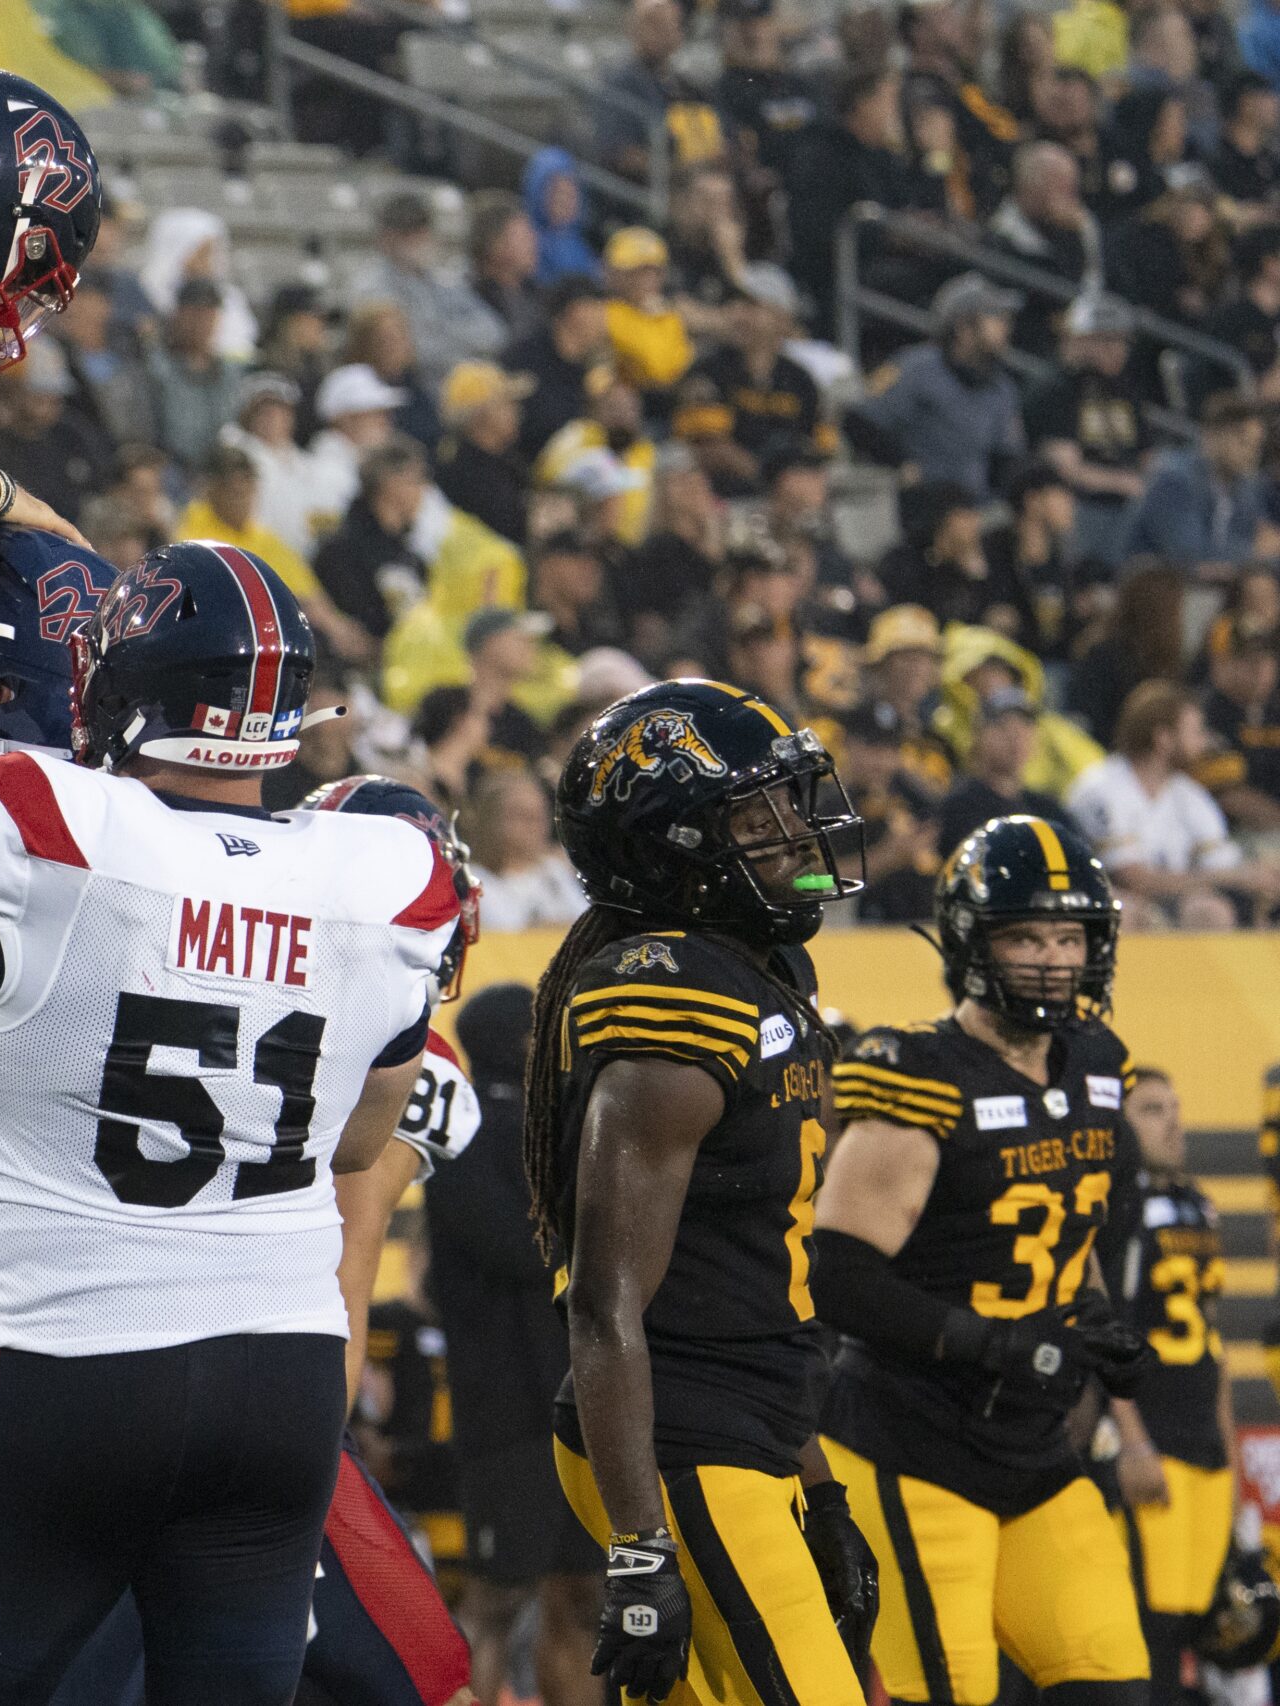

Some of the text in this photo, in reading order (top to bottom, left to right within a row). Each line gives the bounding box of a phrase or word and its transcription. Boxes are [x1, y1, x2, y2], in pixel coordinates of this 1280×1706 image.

[245, 721, 268, 733] LCF
[177, 897, 312, 986] MATTE
[94, 991, 326, 1208] 51
[398, 1068, 456, 1147] 81
[978, 1106, 1025, 1120] TELUS
[999, 1128, 1115, 1178] TIGER-CATS
[628, 1613, 652, 1627] CFL
